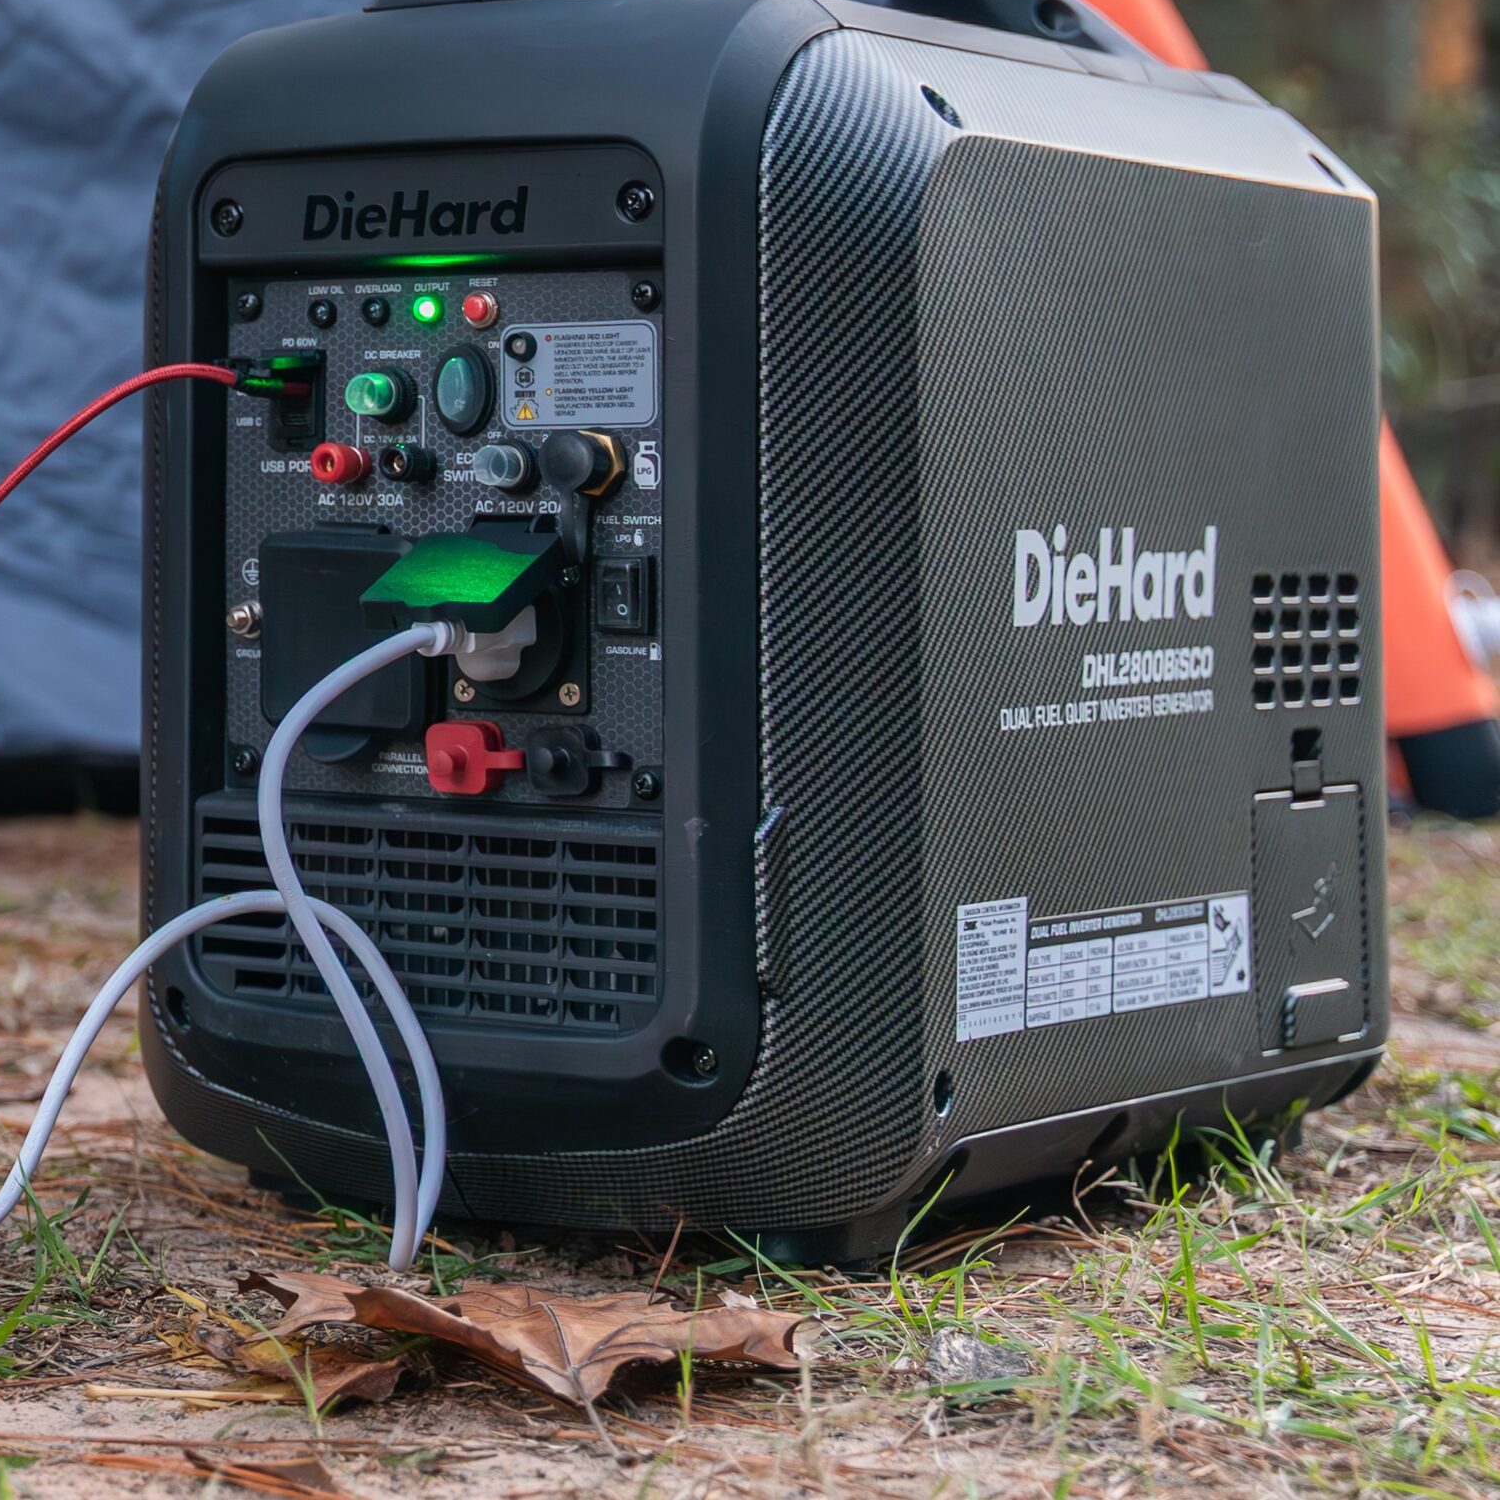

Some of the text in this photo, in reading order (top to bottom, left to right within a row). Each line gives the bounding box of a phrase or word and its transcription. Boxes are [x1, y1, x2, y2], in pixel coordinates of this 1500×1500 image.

[302, 185, 529, 241] DieHard
[414, 282, 450, 293] OUTPUT
[469, 277, 498, 287] RESET
[308, 285, 344, 295] LOW OIL
[355, 283, 402, 294] OVERLOAD
[282, 338, 318, 347] PD 60W
[488, 341, 500, 349] ON
[364, 350, 421, 360] DC BREAKER
[236, 417, 262, 426] USB C
[363, 435, 375, 444] DC
[487, 431, 502, 439] OFF
[456, 452, 476, 465] EC
[260, 460, 312, 473] USB POR
[636, 467, 652, 475] LPG
[443, 469, 476, 482] SWIT
[318, 493, 404, 506] AC 120V 30A
[474, 500, 494, 513] AC
[498, 500, 535, 513] 120V
[597, 515, 662, 526] FUEL SWITCH
[614, 534, 632, 543] LPG
[1013, 523, 1218, 627] DieHard
[605, 645, 647, 656] GASOLINE
[999, 688, 1215, 731] DUAL FUEL QUIET INVERTER GENERATOR
[380, 751, 424, 763] PARALLEL
[371, 763, 429, 775] CONNECTION
[1030, 925, 1050, 940] DUAL
[1050, 922, 1068, 937] FUEL
